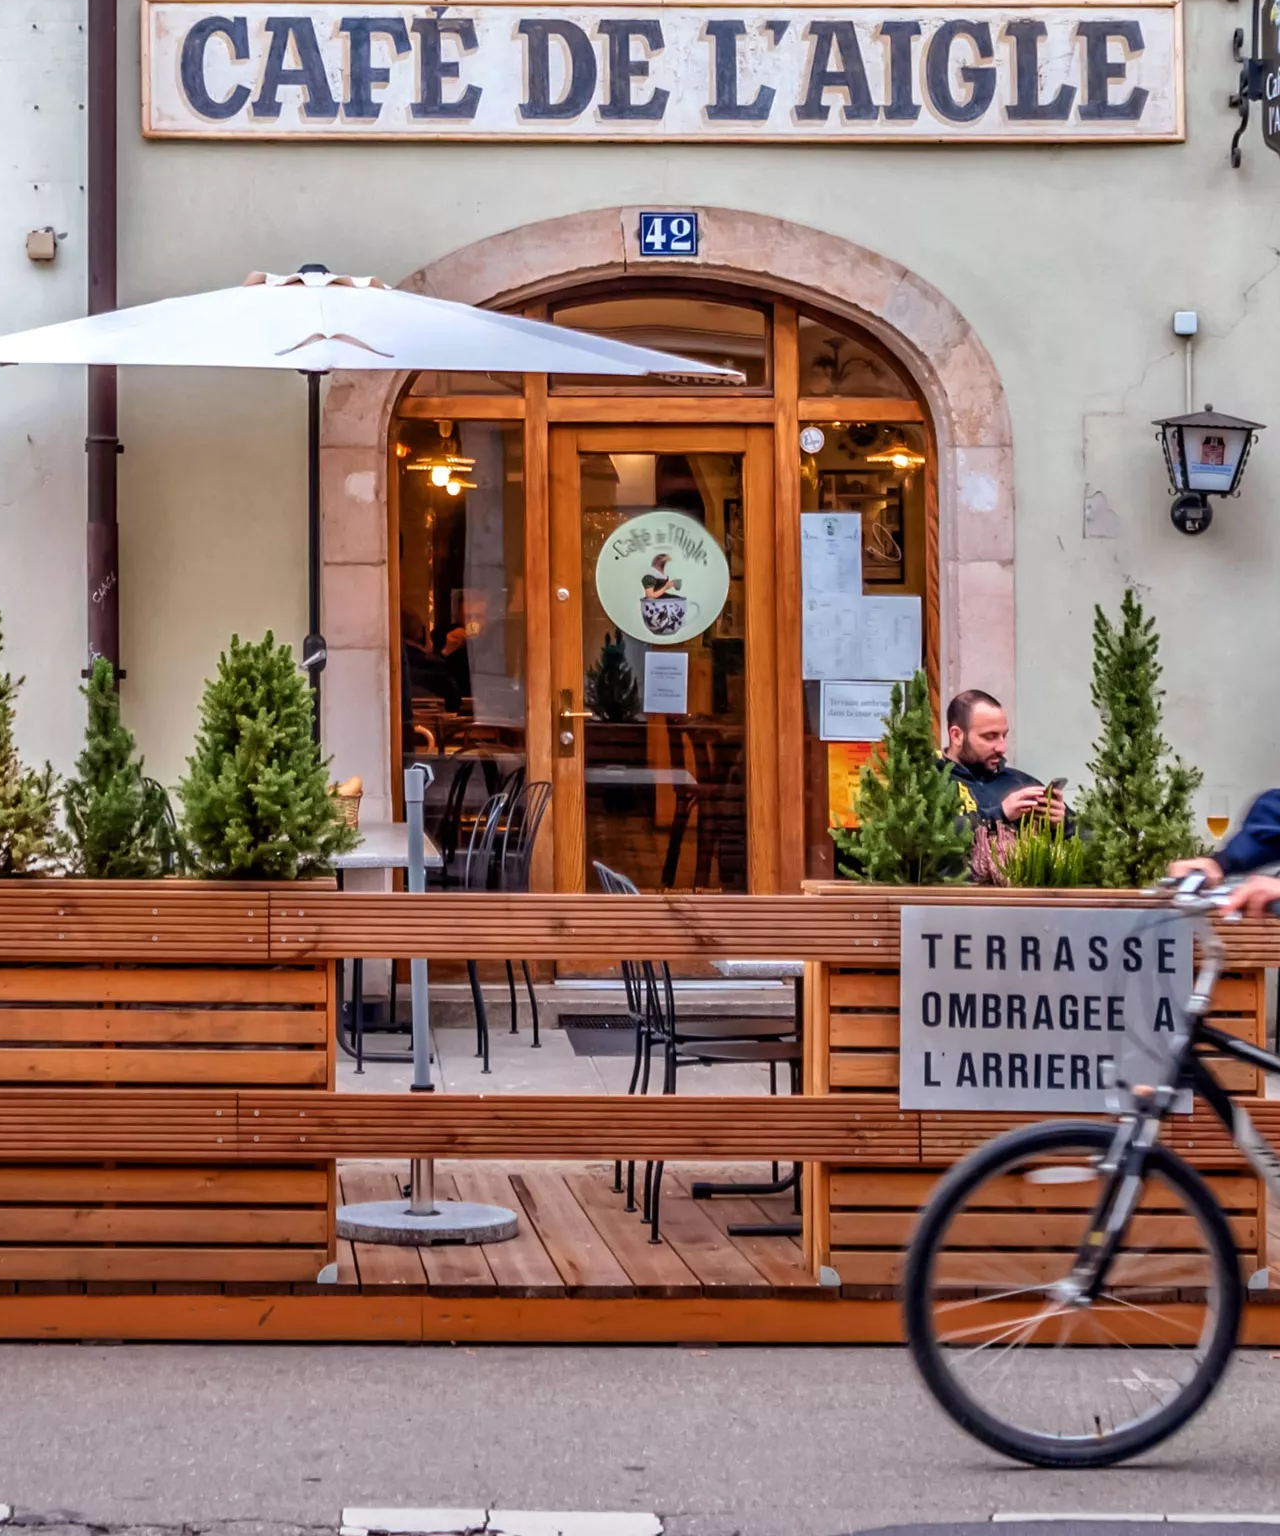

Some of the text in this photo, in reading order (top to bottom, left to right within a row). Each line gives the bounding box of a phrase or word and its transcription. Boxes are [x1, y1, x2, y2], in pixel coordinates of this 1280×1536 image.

[179, 7, 1150, 123] CAFÉ DE L'AIGLE
[645, 218, 692, 250] 42
[921, 933, 1176, 974] TERRASSE
[921, 991, 1176, 1033] OMBRAGEE A
